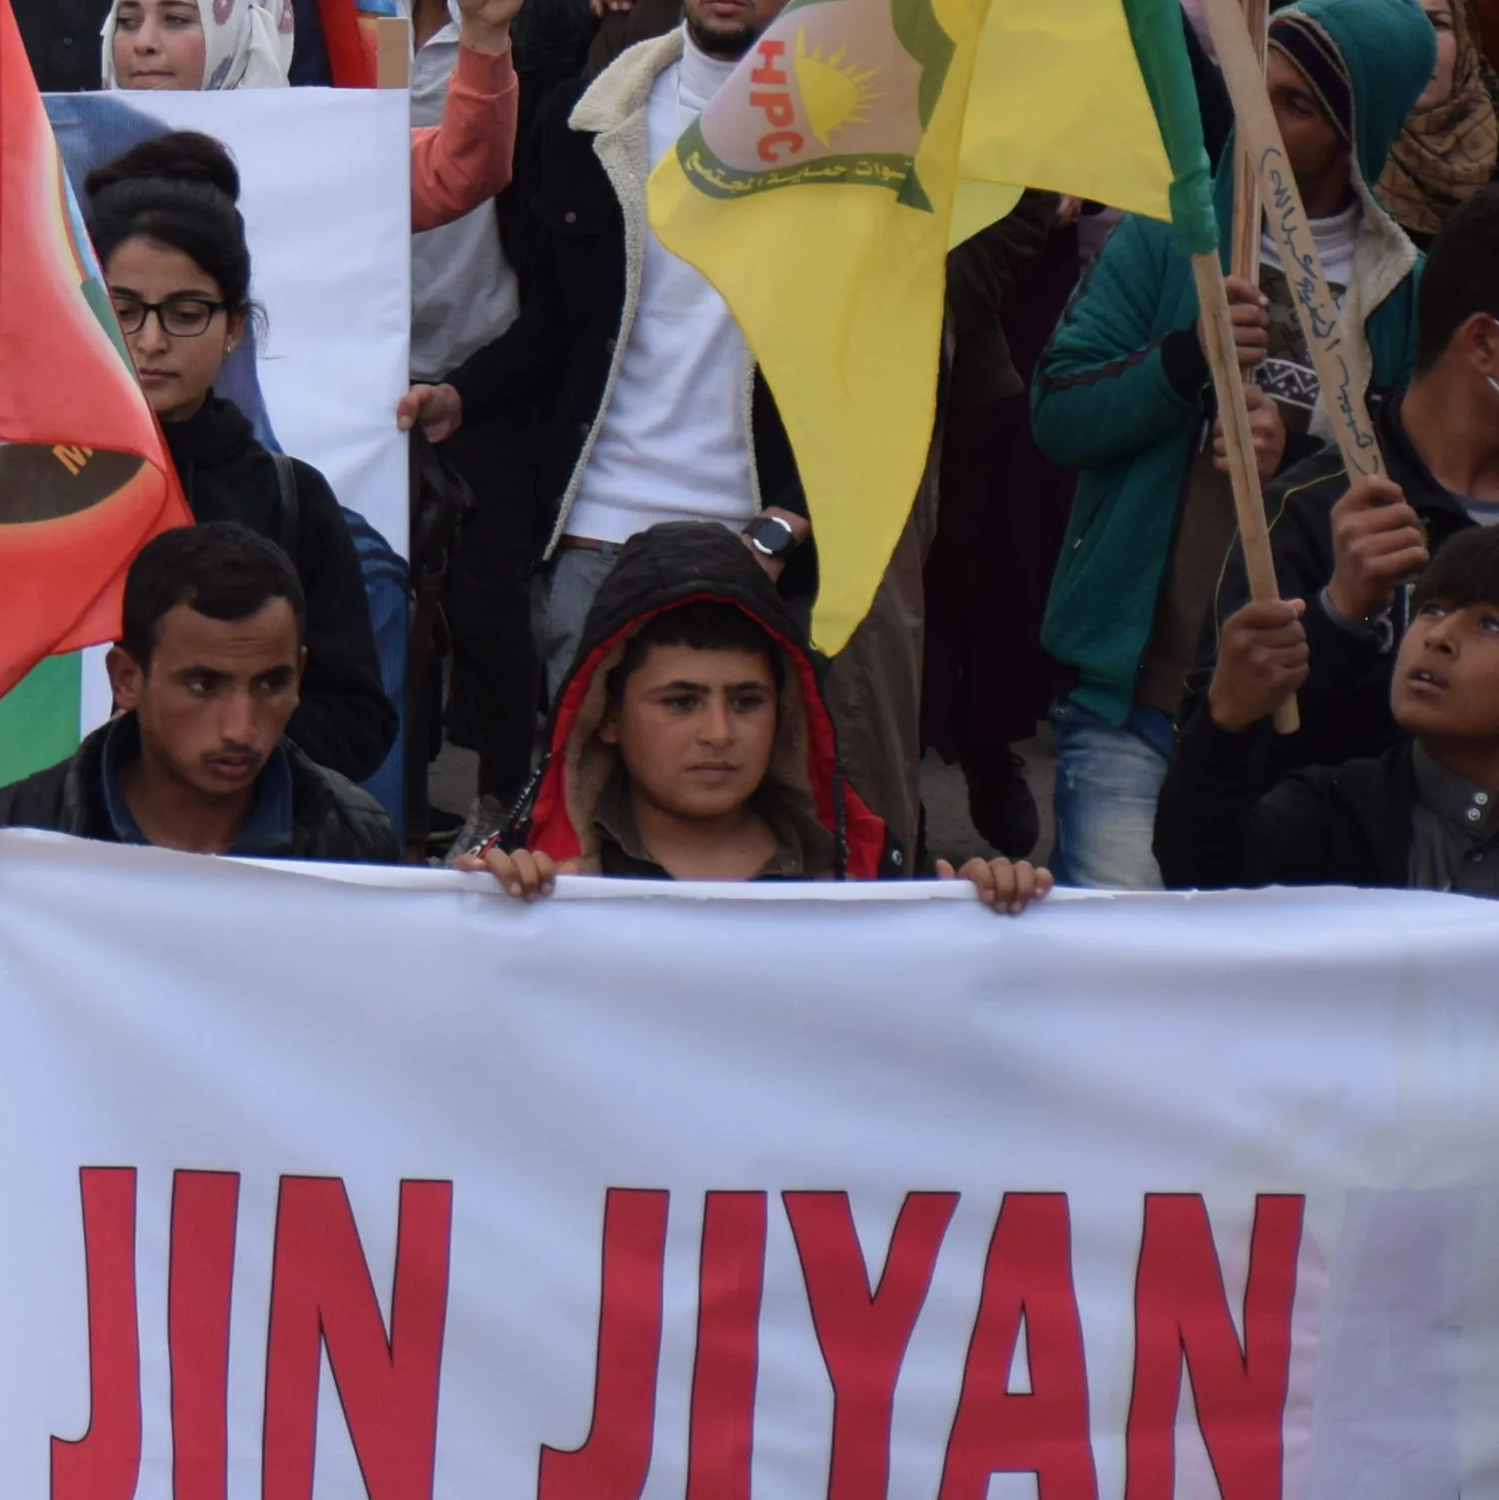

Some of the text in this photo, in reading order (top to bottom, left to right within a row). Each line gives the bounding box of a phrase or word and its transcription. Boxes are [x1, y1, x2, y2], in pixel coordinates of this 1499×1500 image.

[750, 39, 804, 164] HPC
[49, 1166, 1307, 1500] JIN JIYAN
